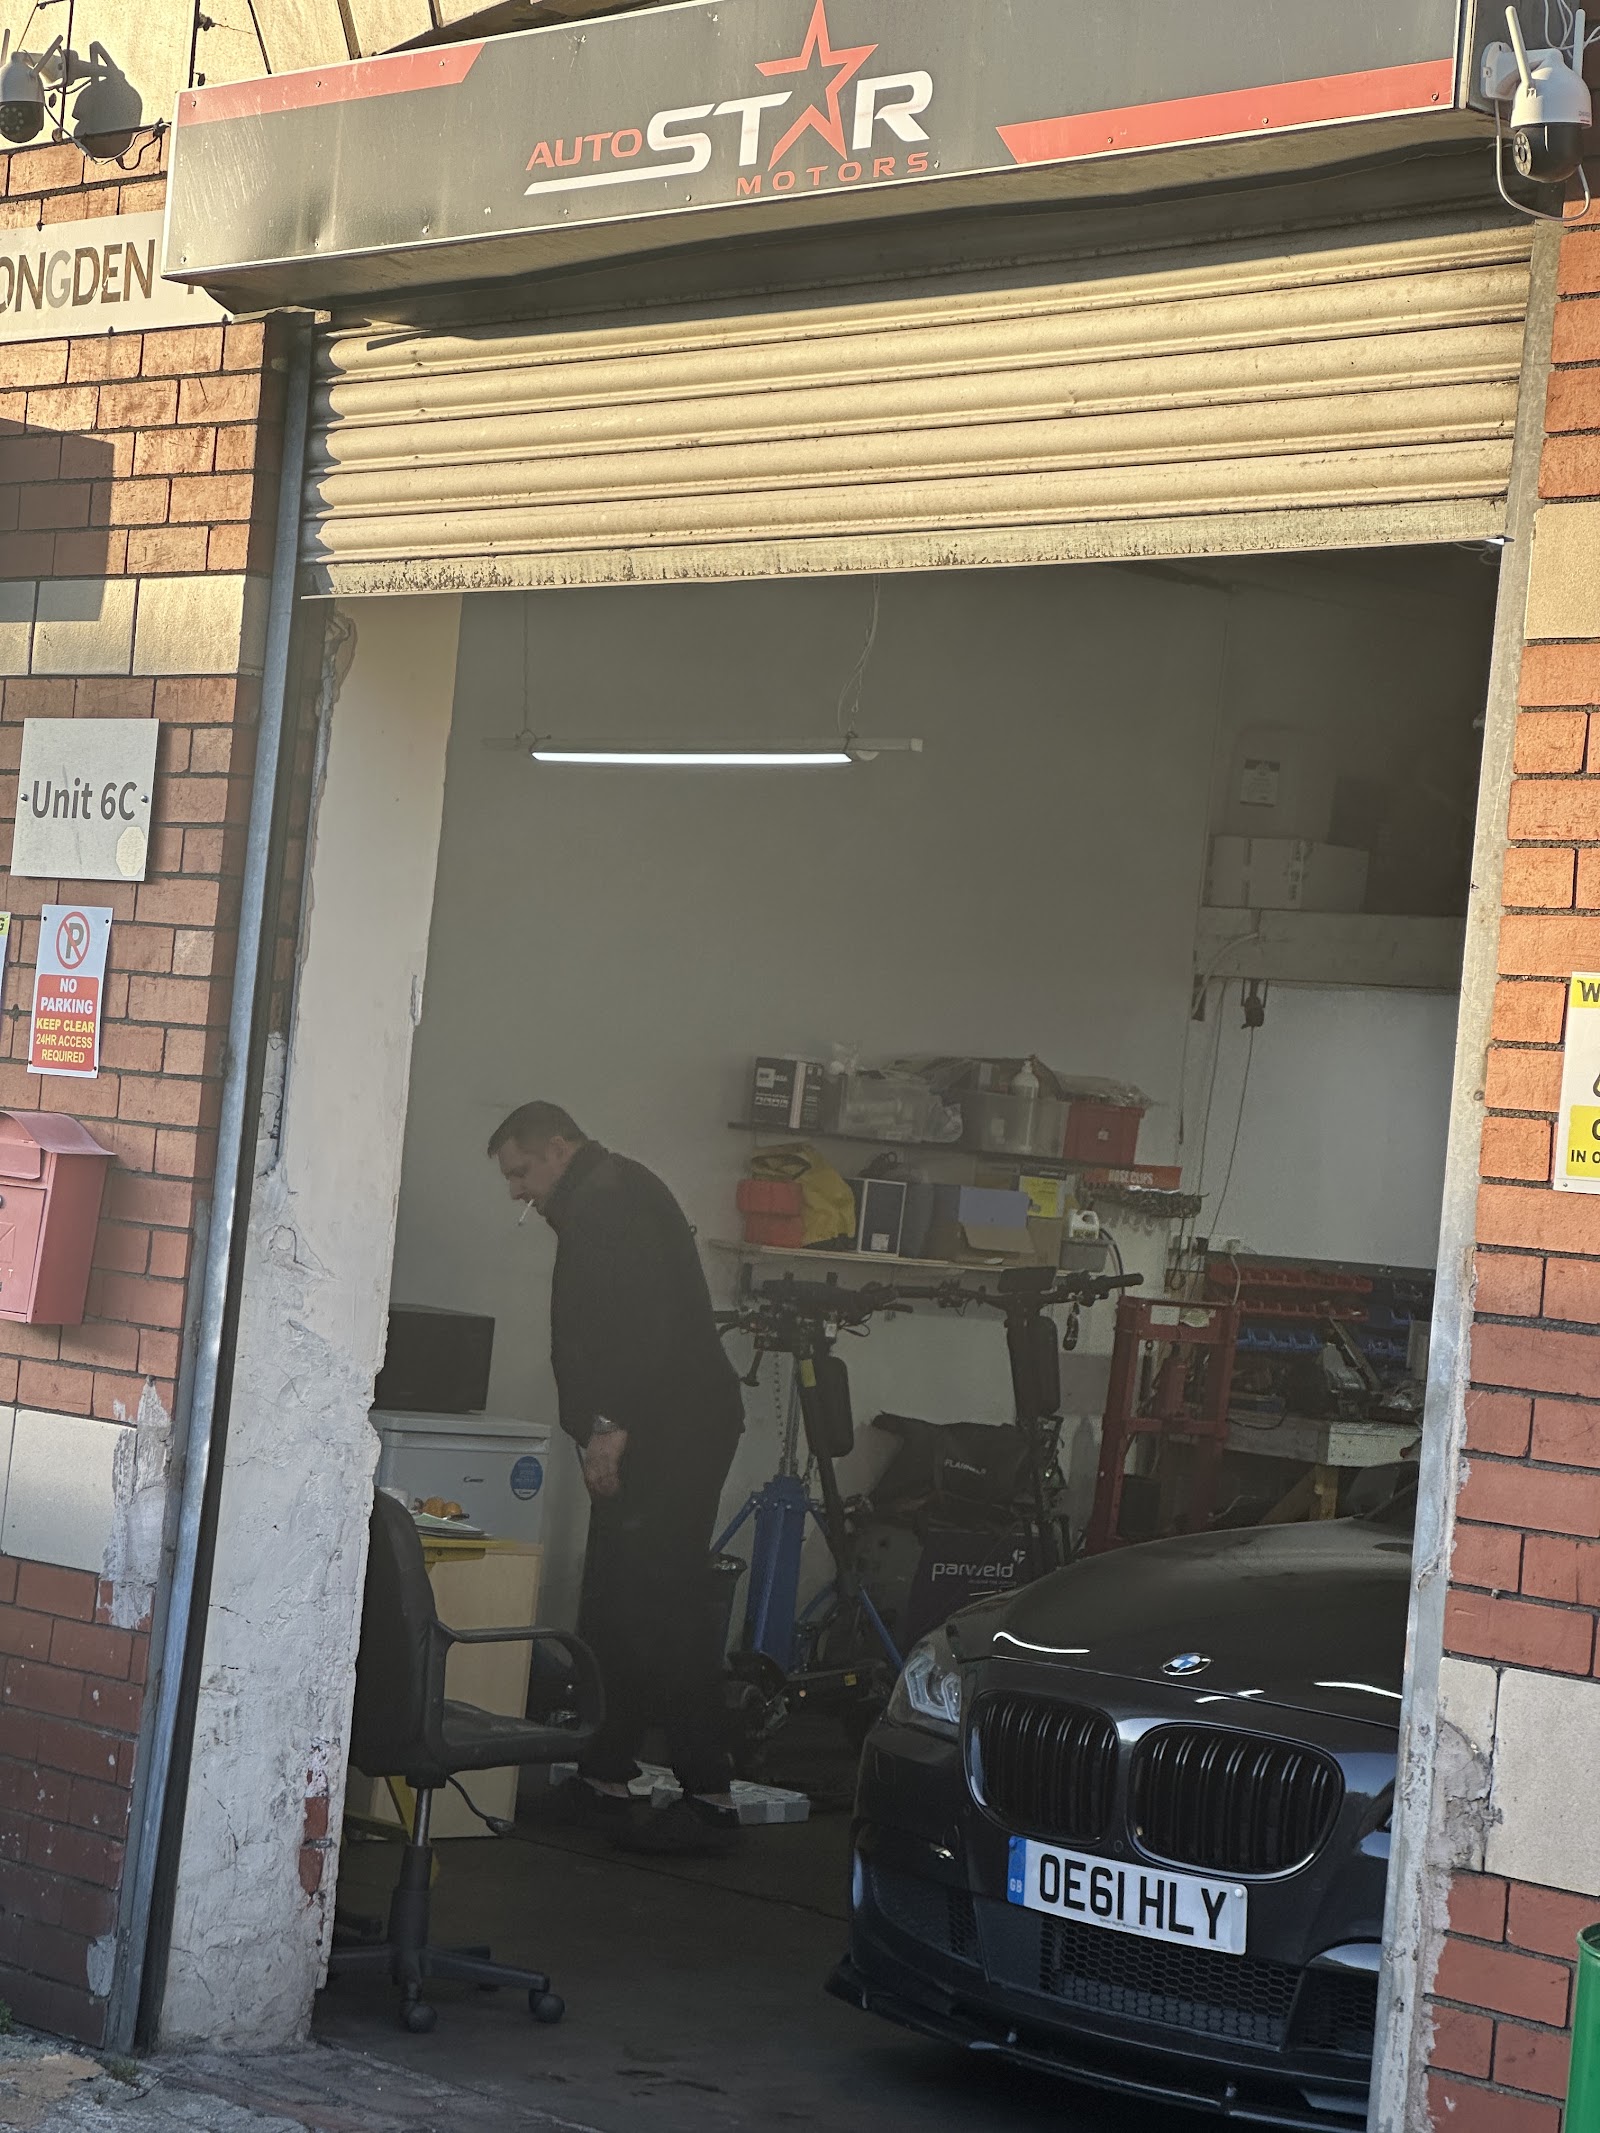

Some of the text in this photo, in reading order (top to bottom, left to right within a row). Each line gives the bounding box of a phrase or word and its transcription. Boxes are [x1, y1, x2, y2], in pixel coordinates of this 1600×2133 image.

[525, 128, 643, 171] AUTO
[736, 151, 930, 196] MOTORS
[32, 777, 138, 821] Unit 6C
[60, 978, 77, 993] NO
[40, 996, 93, 1015] PARKING
[36, 1017, 94, 1033] KEEP CLEAR
[36, 1033, 92, 1049] 24HR ACCESS
[41, 1048, 85, 1064] REQUIRED
[1570, 1149, 1587, 1163] IN
[931, 1562, 1014, 1582] parweld
[1009, 1853, 1227, 1940] GB OE61 HLY
